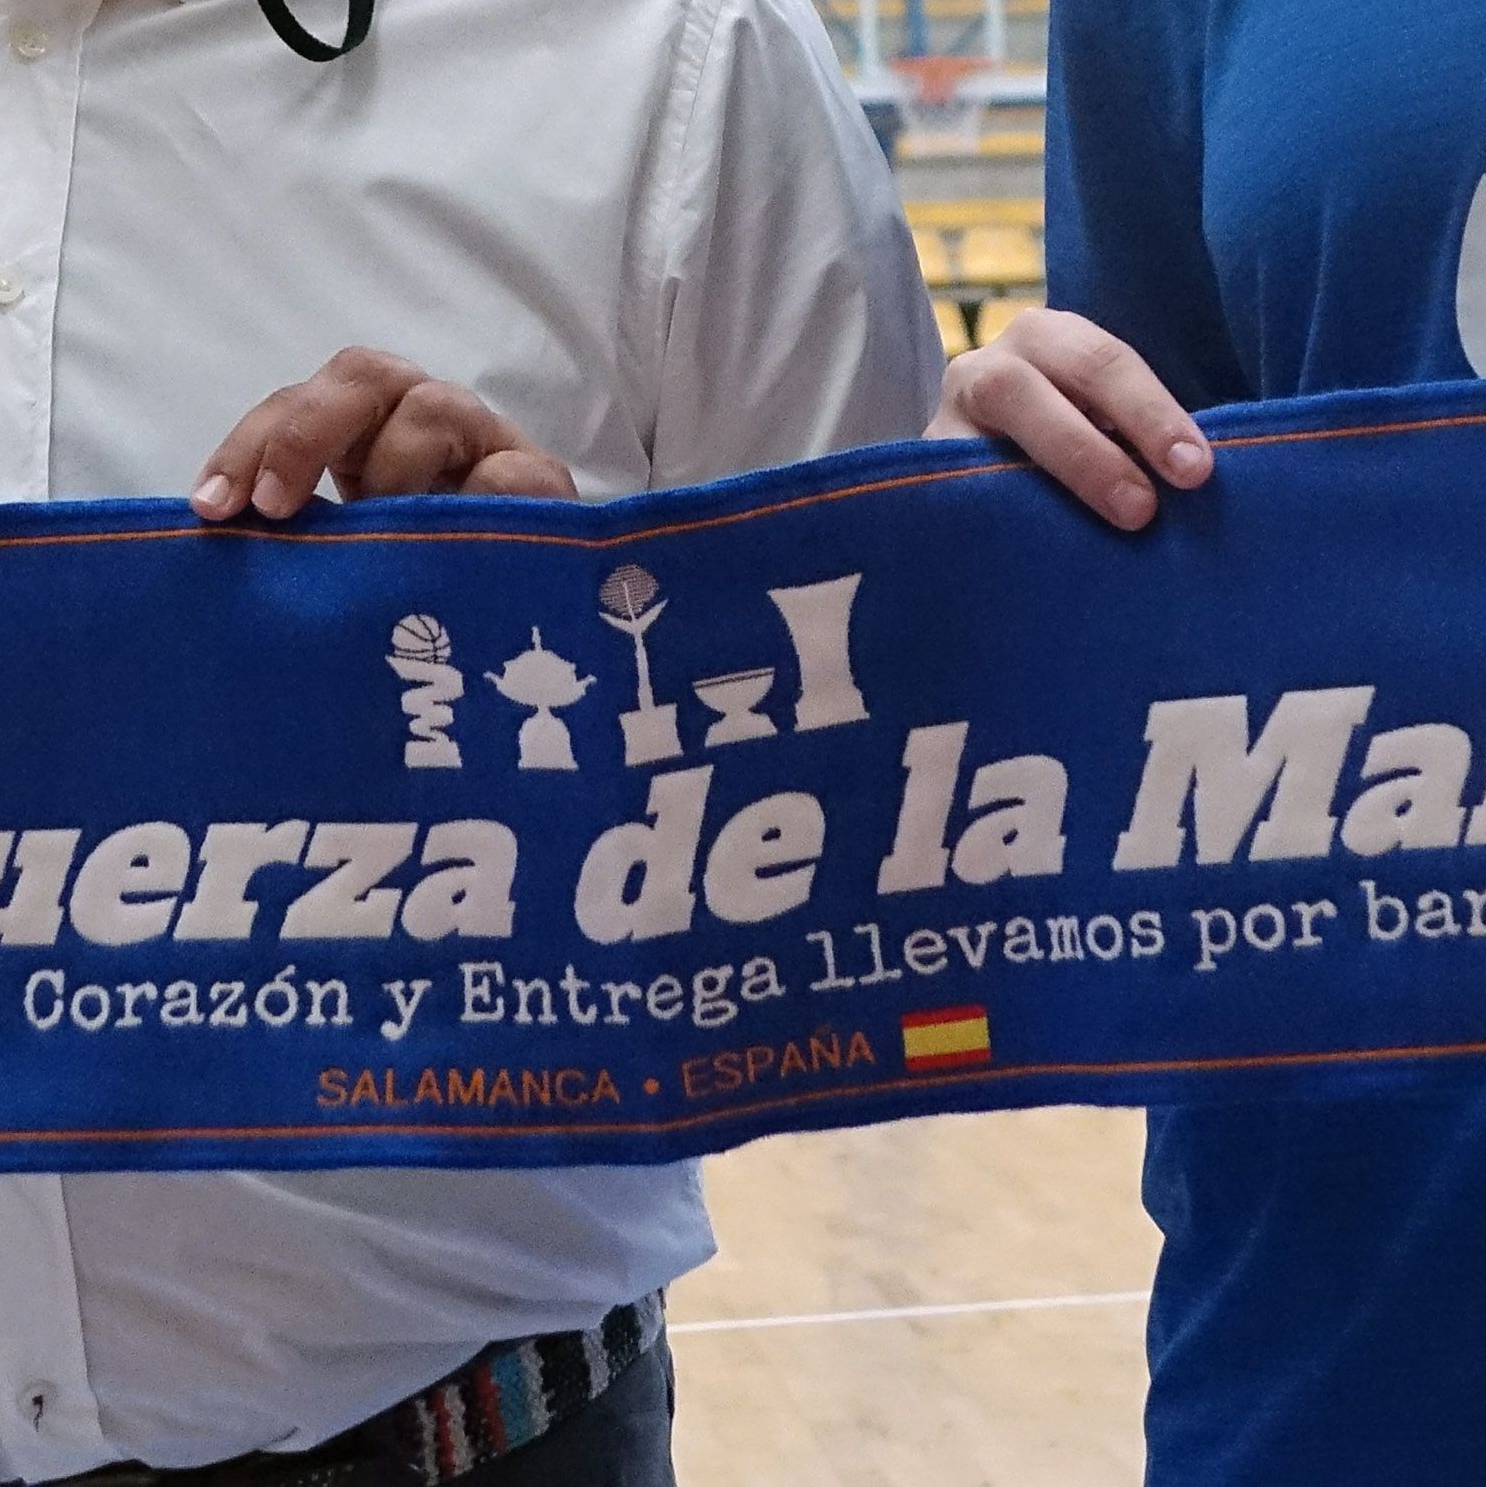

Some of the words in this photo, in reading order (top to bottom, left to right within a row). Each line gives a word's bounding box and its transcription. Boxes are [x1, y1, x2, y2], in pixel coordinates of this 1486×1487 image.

[574, 764, 826, 945] de
[877, 720, 1069, 895] la
[23, 964, 354, 1032] Corazón
[380, 979, 433, 1042] y
[458, 956, 787, 1028] Entrega
[807, 907, 1166, 992] llevamos
[1192, 896, 1339, 972] por
[316, 1067, 621, 1108] SALAMANCA
[681, 1027, 877, 1100] ESPAÑA
